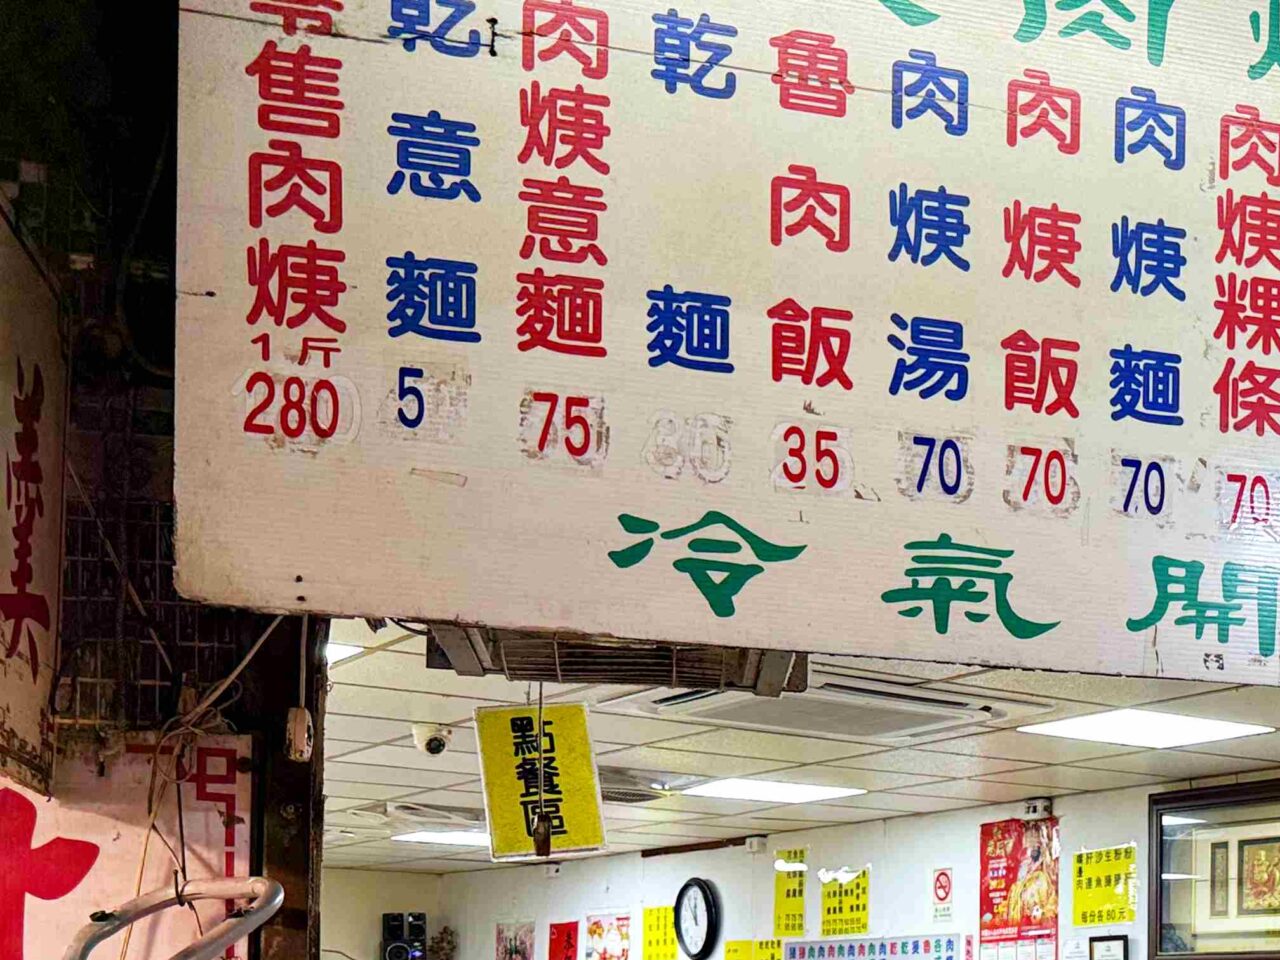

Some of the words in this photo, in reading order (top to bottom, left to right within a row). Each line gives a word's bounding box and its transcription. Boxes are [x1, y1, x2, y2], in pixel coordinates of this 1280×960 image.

[516, 0, 611, 358] 肉焿意麵
[646, 8, 738, 374] 乾麵
[766, 30, 855, 391] 魯肉飯
[887, 49, 971, 402] 肉焿湯
[1001, 68, 1082, 420] 肉焿飯
[1108, 86, 1187, 426] 肉焿麵
[243, 372, 340, 438] 280
[533, 392, 590, 456] 75
[781, 426, 840, 489] 35
[912, 436, 962, 496] 70
[1020, 447, 1066, 505] 70
[1121, 459, 1166, 517] 70
[1226, 474, 1270, 525] 70
[510, 715, 568, 839] 點餐區
